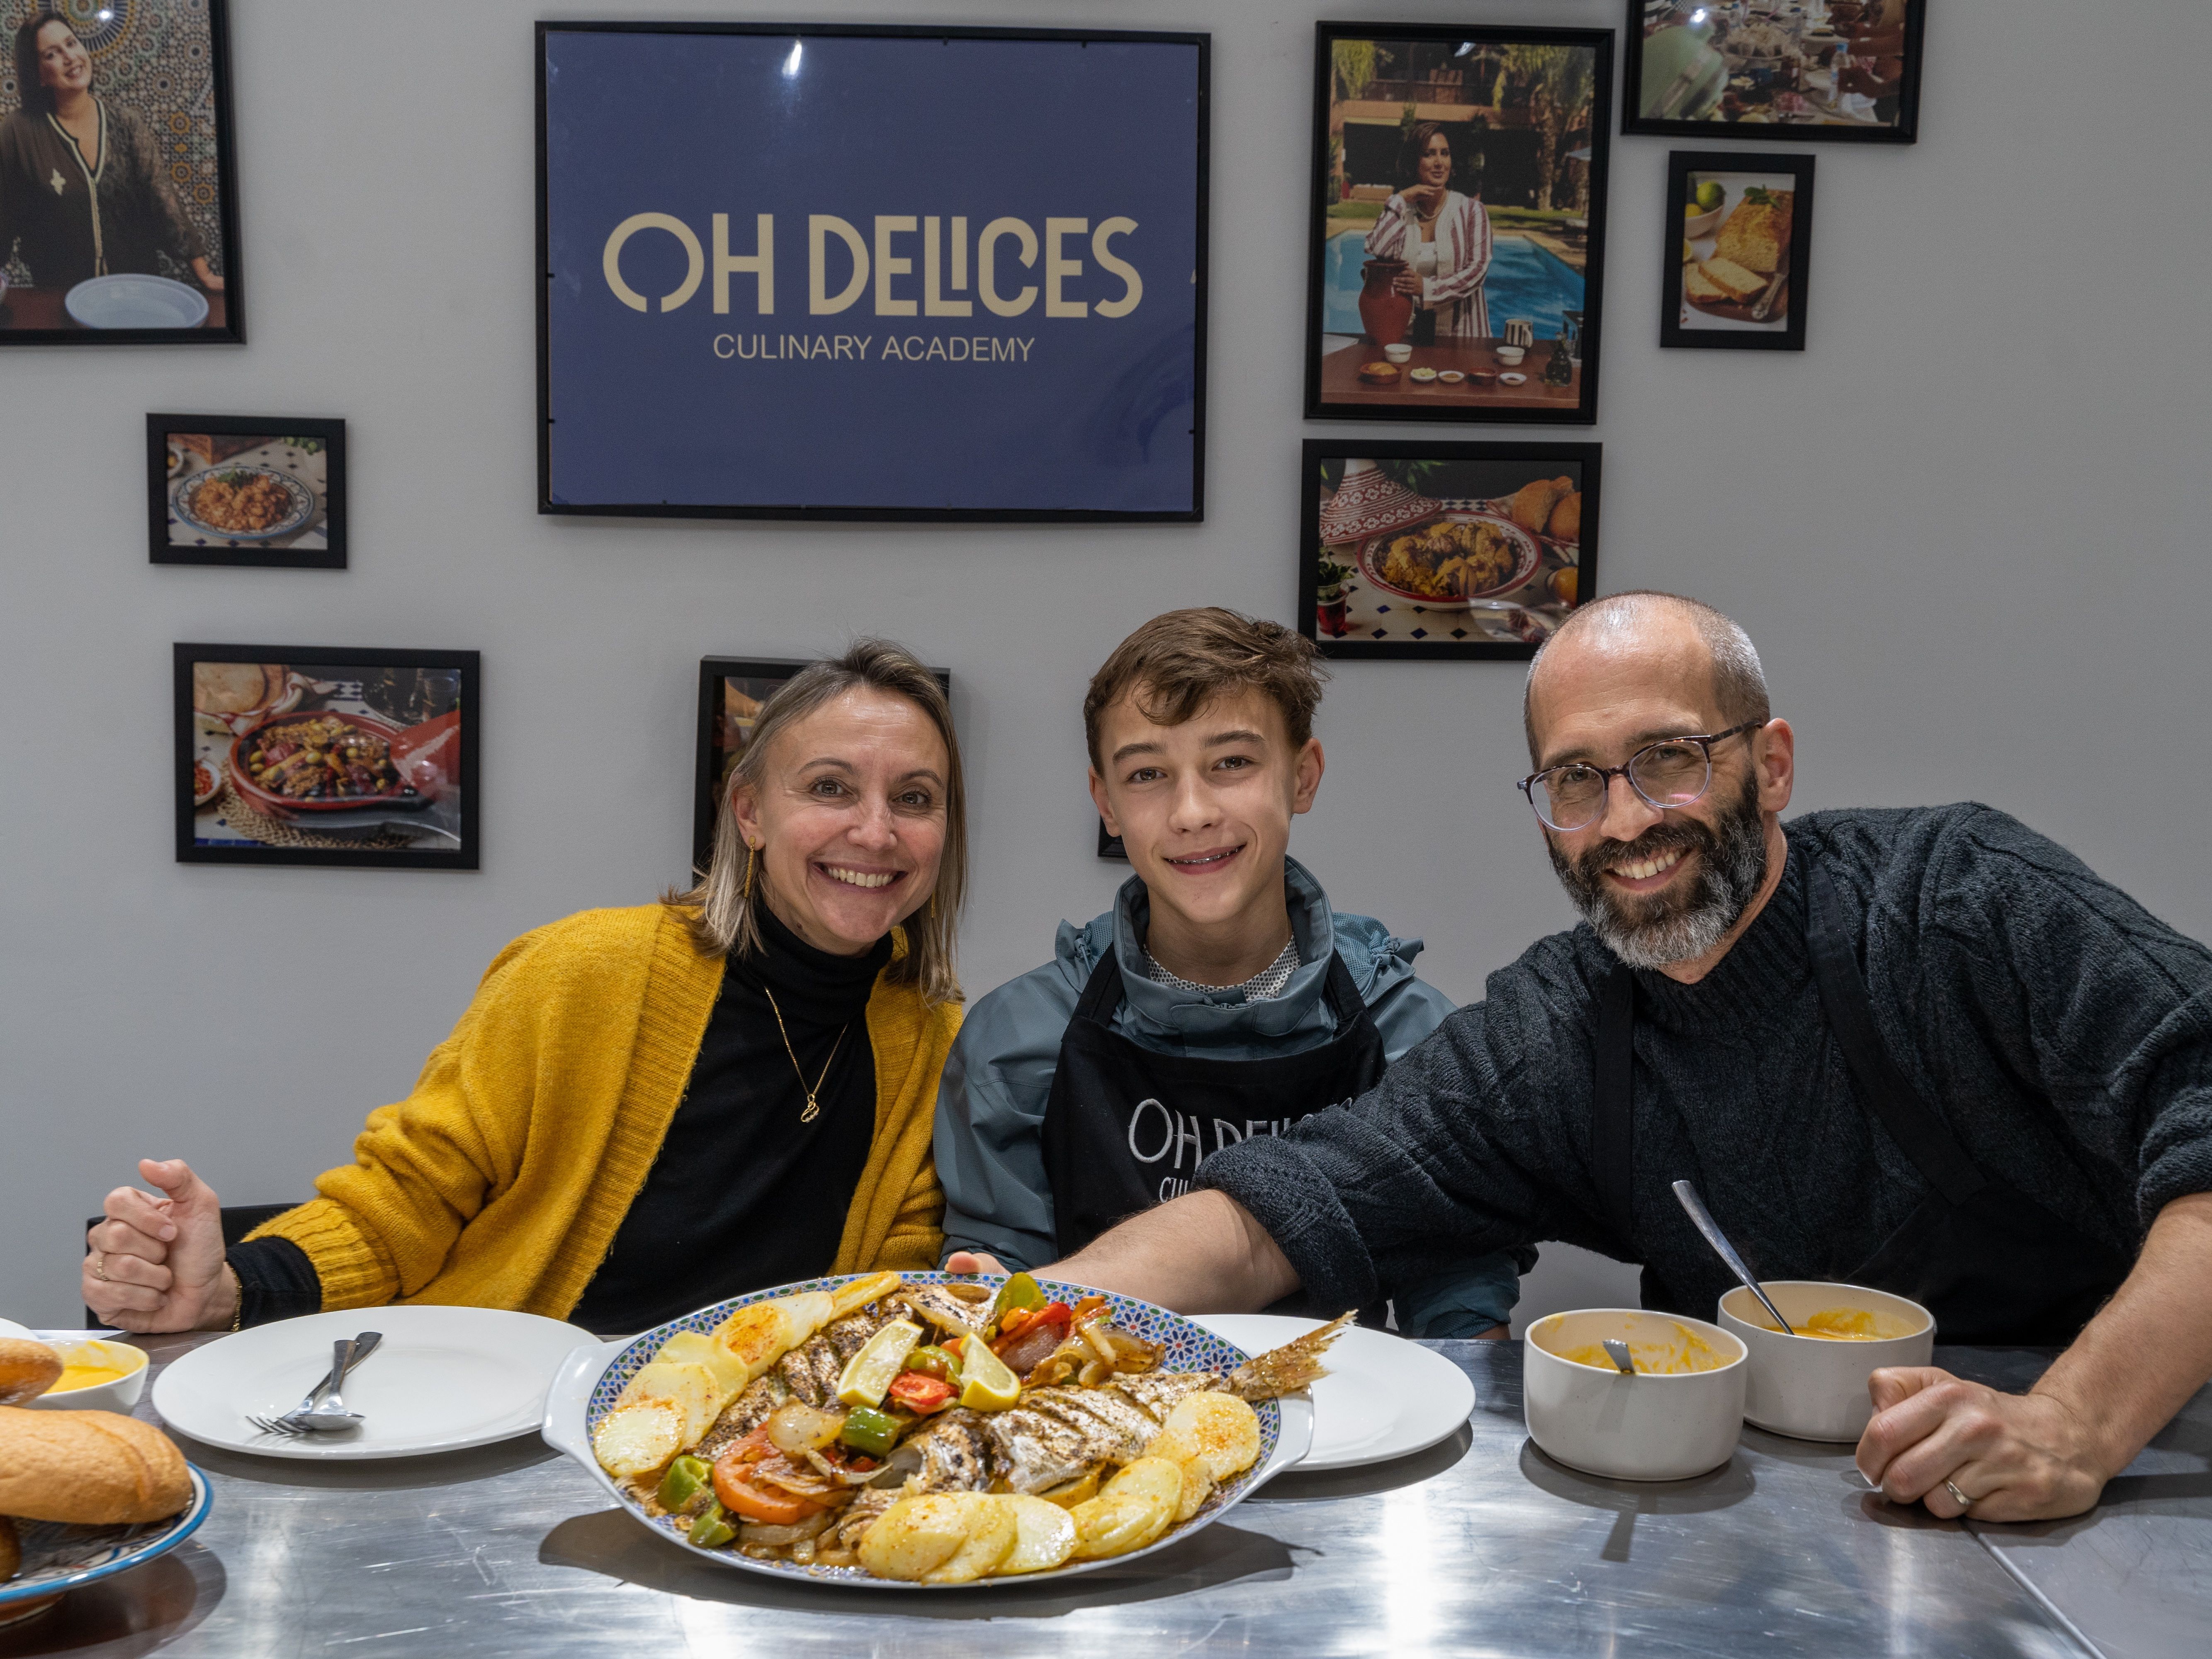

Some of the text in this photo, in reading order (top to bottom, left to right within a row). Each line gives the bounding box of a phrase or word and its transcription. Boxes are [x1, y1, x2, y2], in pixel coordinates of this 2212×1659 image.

[603, 212, 1143, 318] OH DELICES
[713, 334, 1035, 361] CULINARY ACADEMY
[1128, 1098, 1202, 1171] OH
